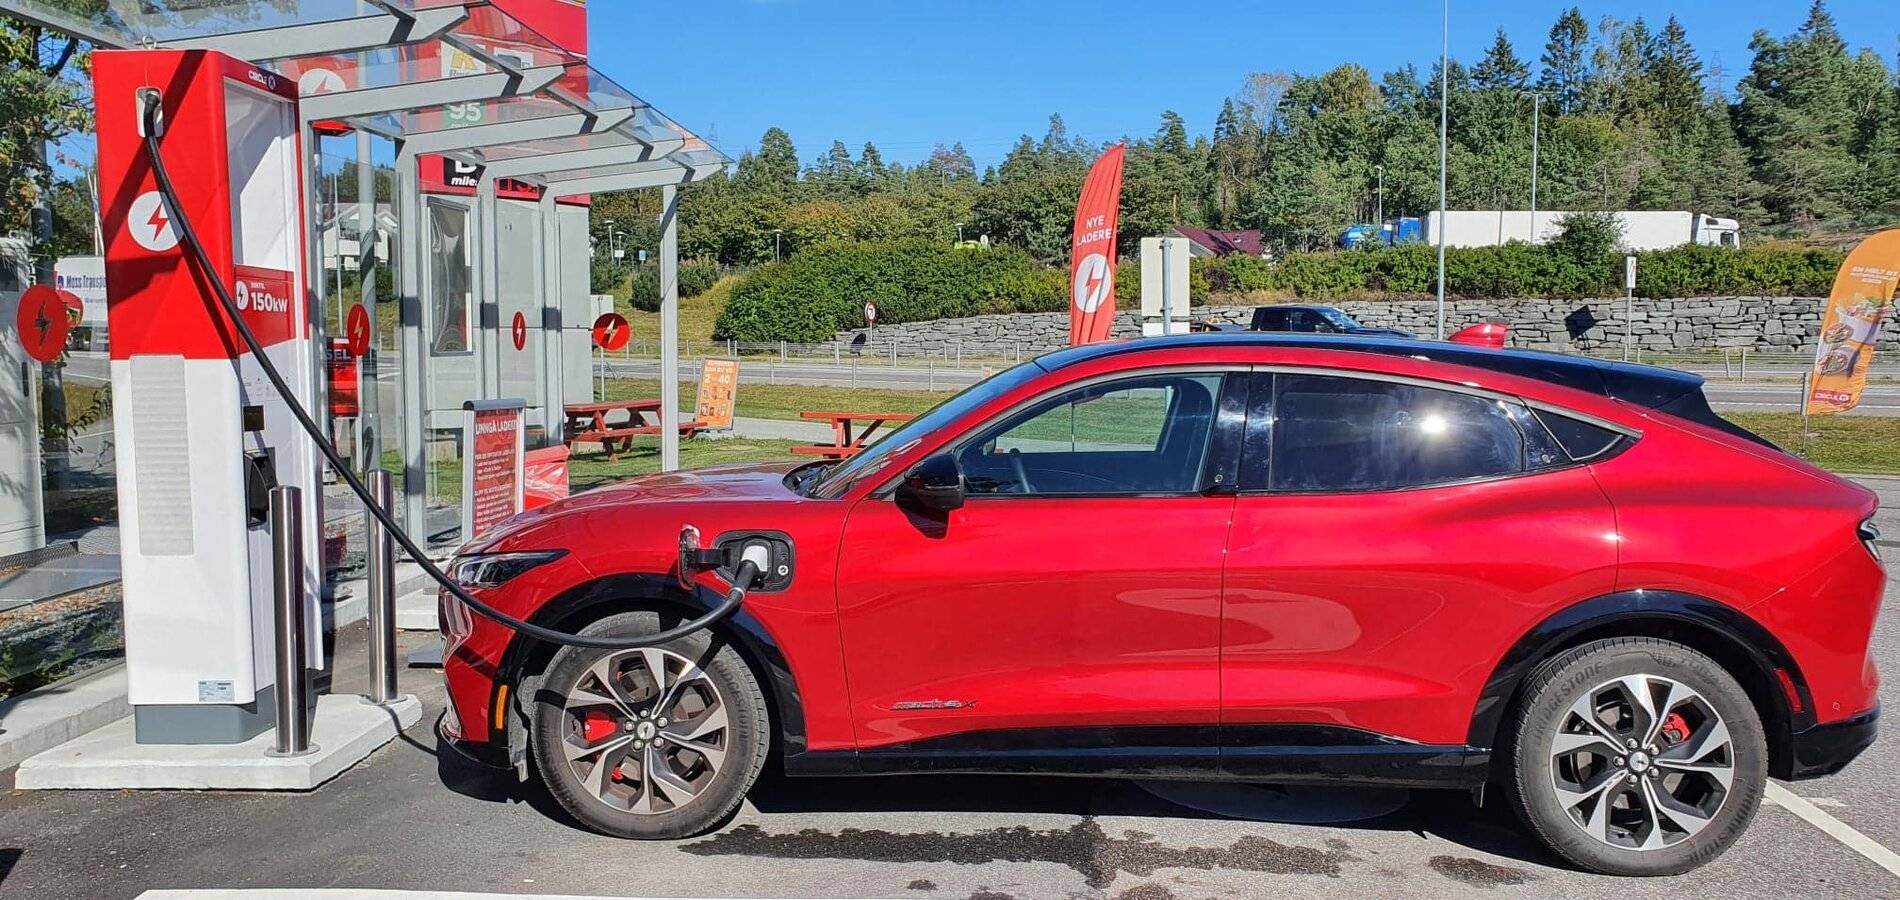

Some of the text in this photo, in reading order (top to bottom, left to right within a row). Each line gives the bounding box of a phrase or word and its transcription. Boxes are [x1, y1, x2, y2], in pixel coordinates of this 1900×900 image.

[449, 102, 482, 122] 95
[451, 176, 479, 187] mile
[1086, 214, 1105, 229] NYE
[1076, 228, 1112, 246] LADERE
[250, 292, 288, 313] 150kW
